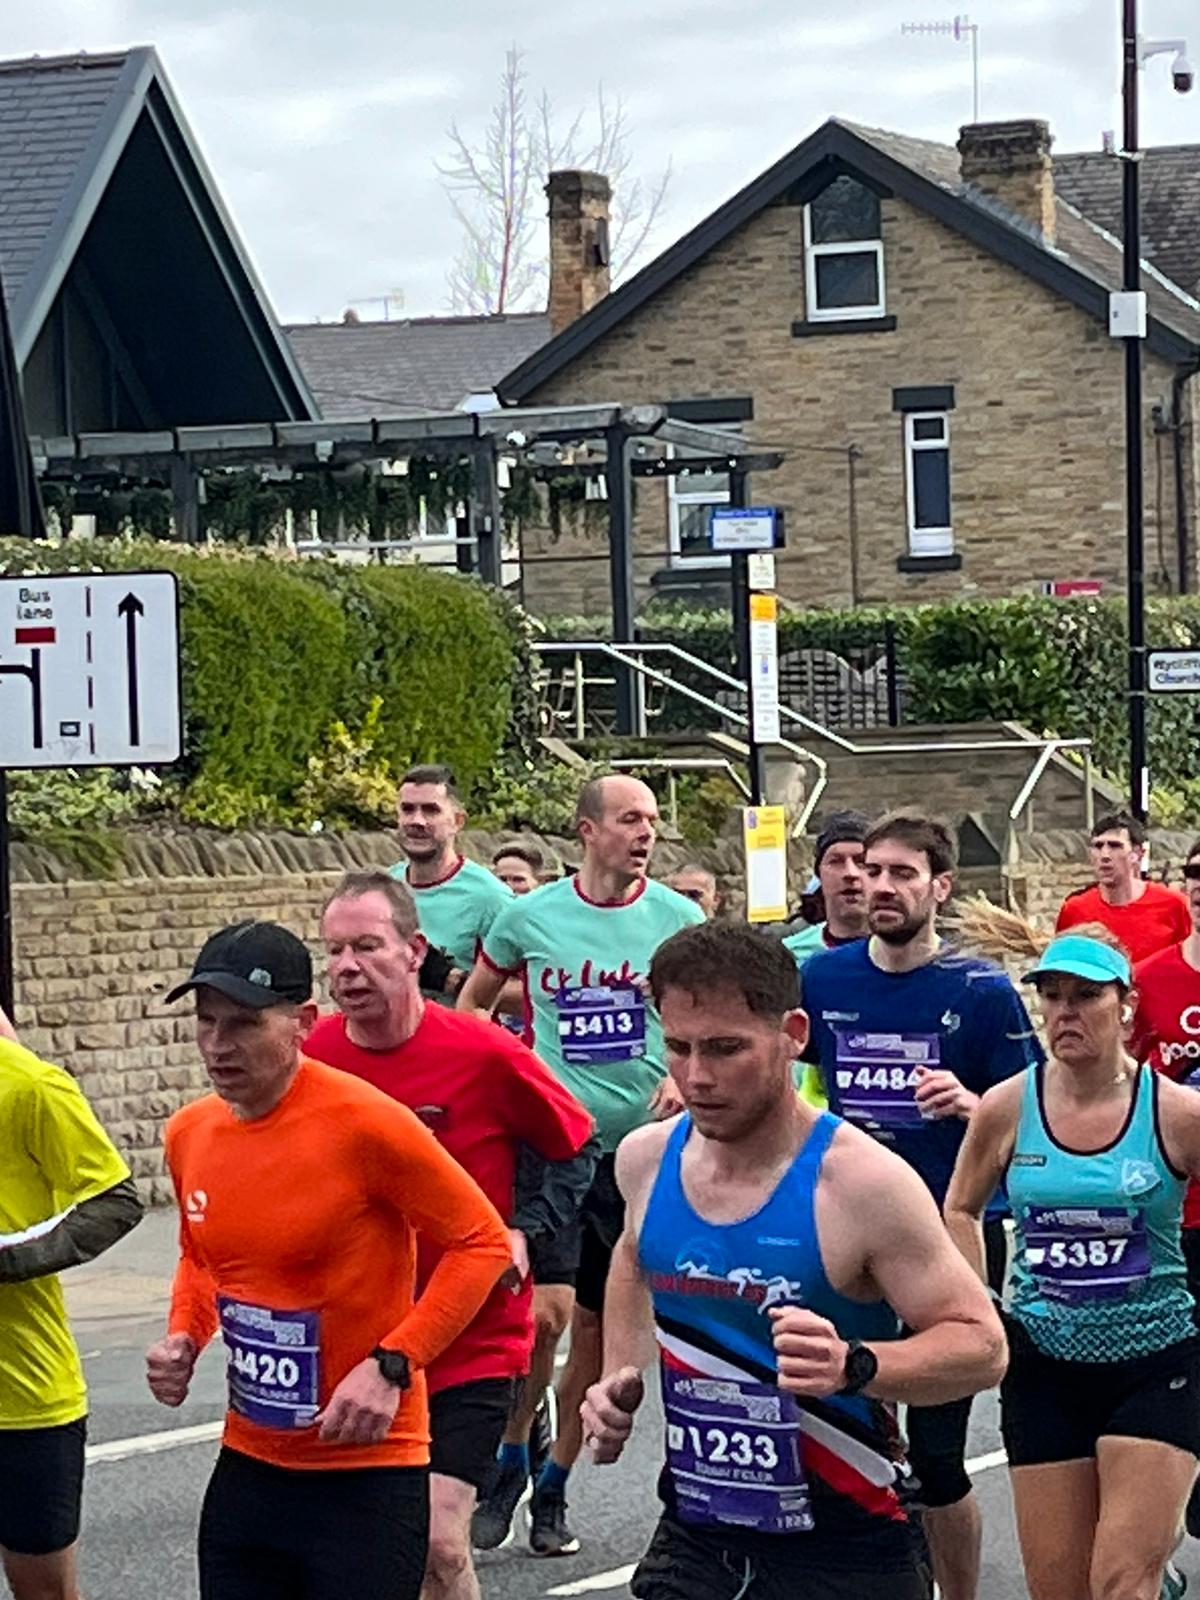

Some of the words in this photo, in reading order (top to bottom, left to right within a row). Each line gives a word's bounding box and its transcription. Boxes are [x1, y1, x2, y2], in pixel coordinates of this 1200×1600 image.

[19, 587, 51, 603] Bus
[16, 604, 53, 620] lane
[574, 1012, 633, 1036] 5413
[1048, 1239, 1128, 1268] 5387
[688, 1426, 778, 1468] 1233
